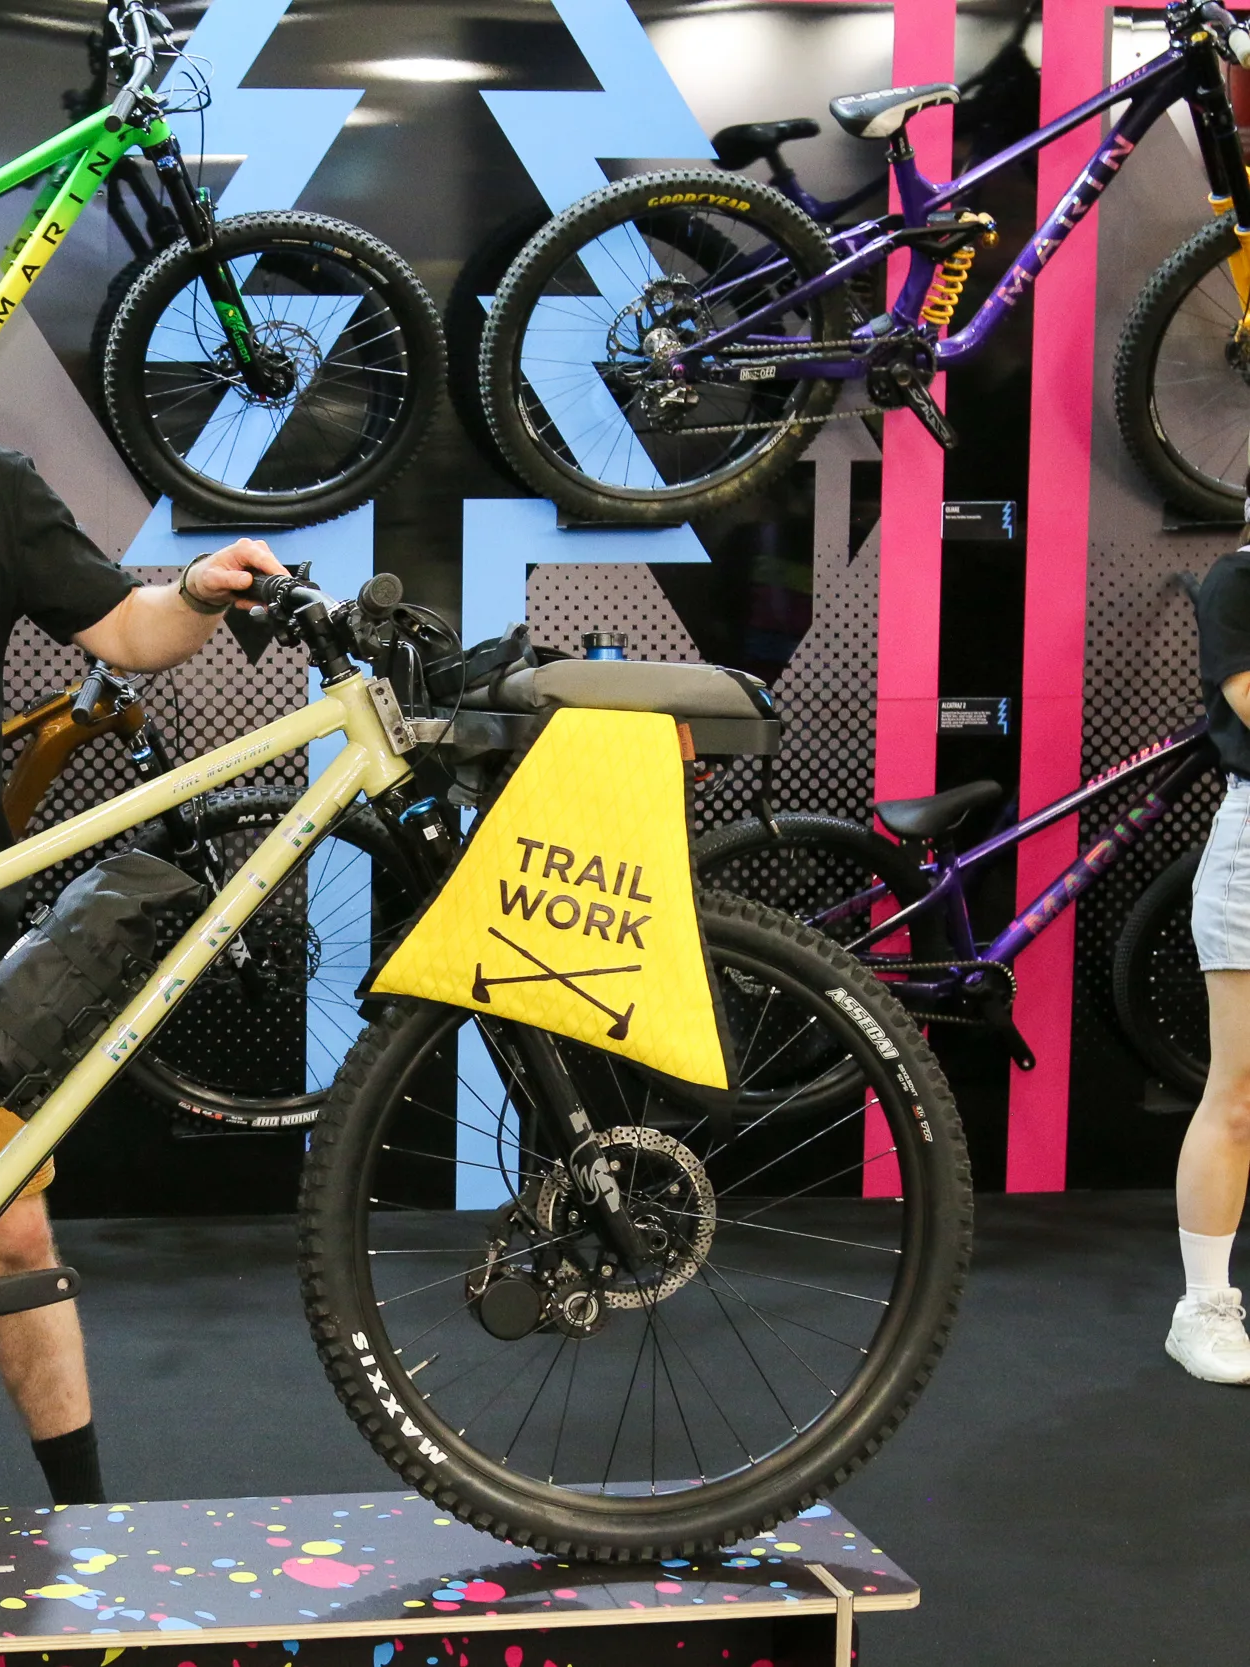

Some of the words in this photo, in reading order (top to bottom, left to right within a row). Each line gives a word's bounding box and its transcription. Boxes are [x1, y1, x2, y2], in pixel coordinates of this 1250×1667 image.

[648, 193, 750, 211] GOODYEAR
[997, 133, 1135, 306] MARIN
[499, 879, 653, 950] WORK
[516, 836, 653, 904] TRAIL
[1022, 792, 1166, 935] MARIN
[101, 813, 316, 1062] MARIN
[825, 987, 900, 1060] ASSEGAI
[351, 1331, 448, 1465] MAXXIS
